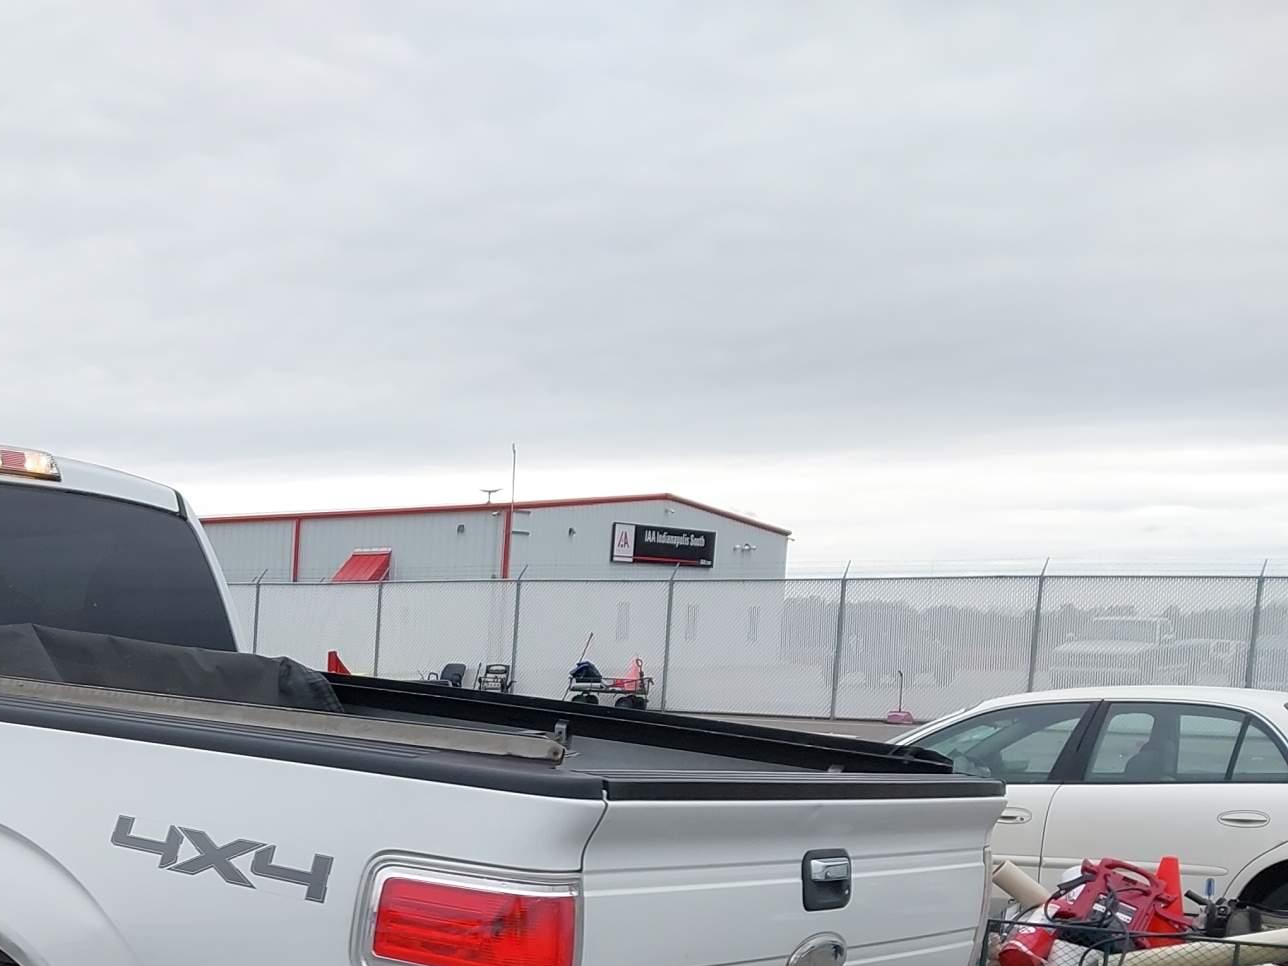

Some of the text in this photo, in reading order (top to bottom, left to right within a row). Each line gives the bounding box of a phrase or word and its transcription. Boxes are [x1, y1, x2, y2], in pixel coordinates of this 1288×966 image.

[644, 529, 705, 548] IAA Indianapolis South
